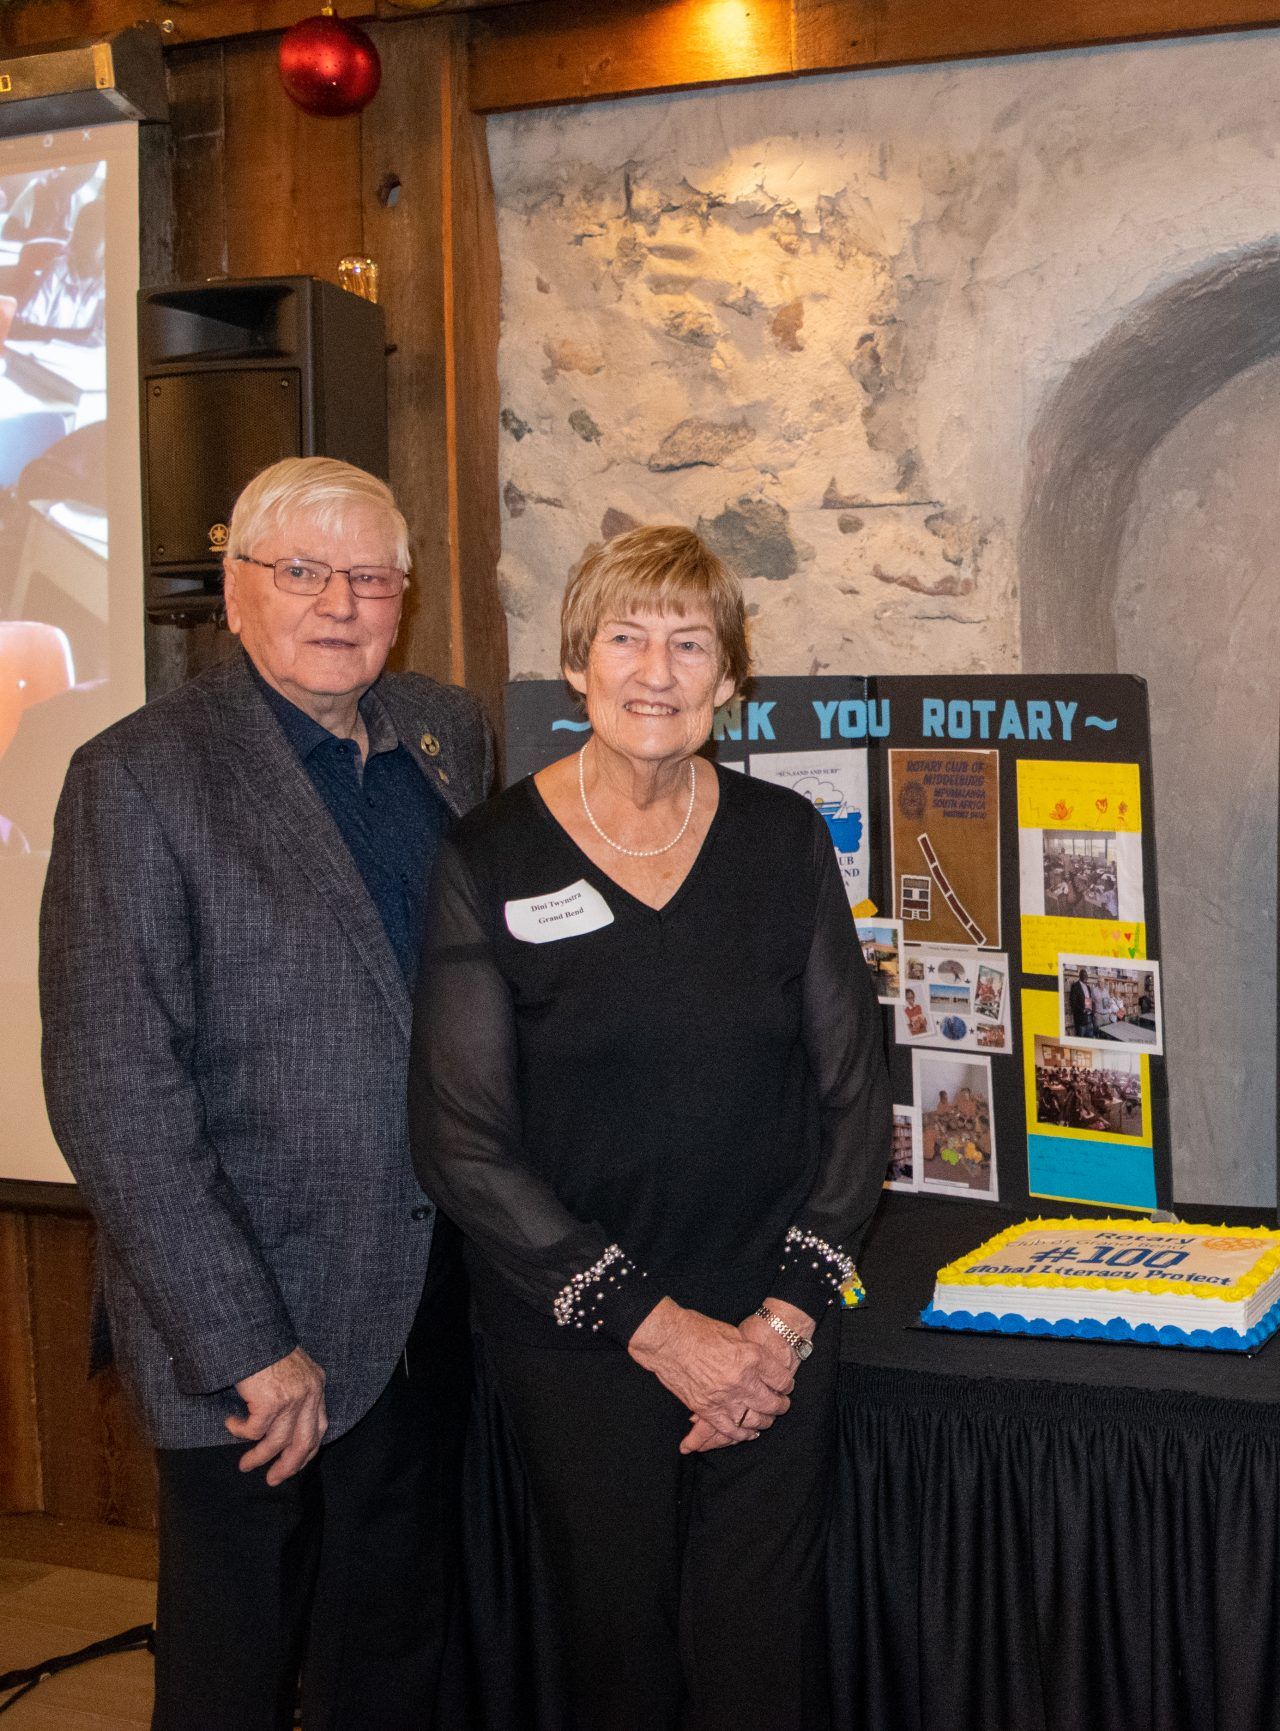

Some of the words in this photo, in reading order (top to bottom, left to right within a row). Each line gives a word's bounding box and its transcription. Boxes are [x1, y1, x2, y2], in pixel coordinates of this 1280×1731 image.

[812, 698, 891, 739] YOU
[922, 697, 1078, 742] ROTARY
[906, 760, 943, 773] ROTARY
[945, 760, 969, 772] CLUB
[971, 761, 985, 772] OF
[531, 903, 548, 912] Dini
[550, 892, 582, 908] Twynstra
[538, 913, 564, 925] Grand
[565, 906, 584, 918] Bend
[1094, 1232, 1196, 1245] Rotary
[1029, 1245, 1191, 1269] #100
[964, 1264, 1037, 1274] Global
[1039, 1264, 1139, 1279] Literacy
[1144, 1269, 1233, 1286] Project
